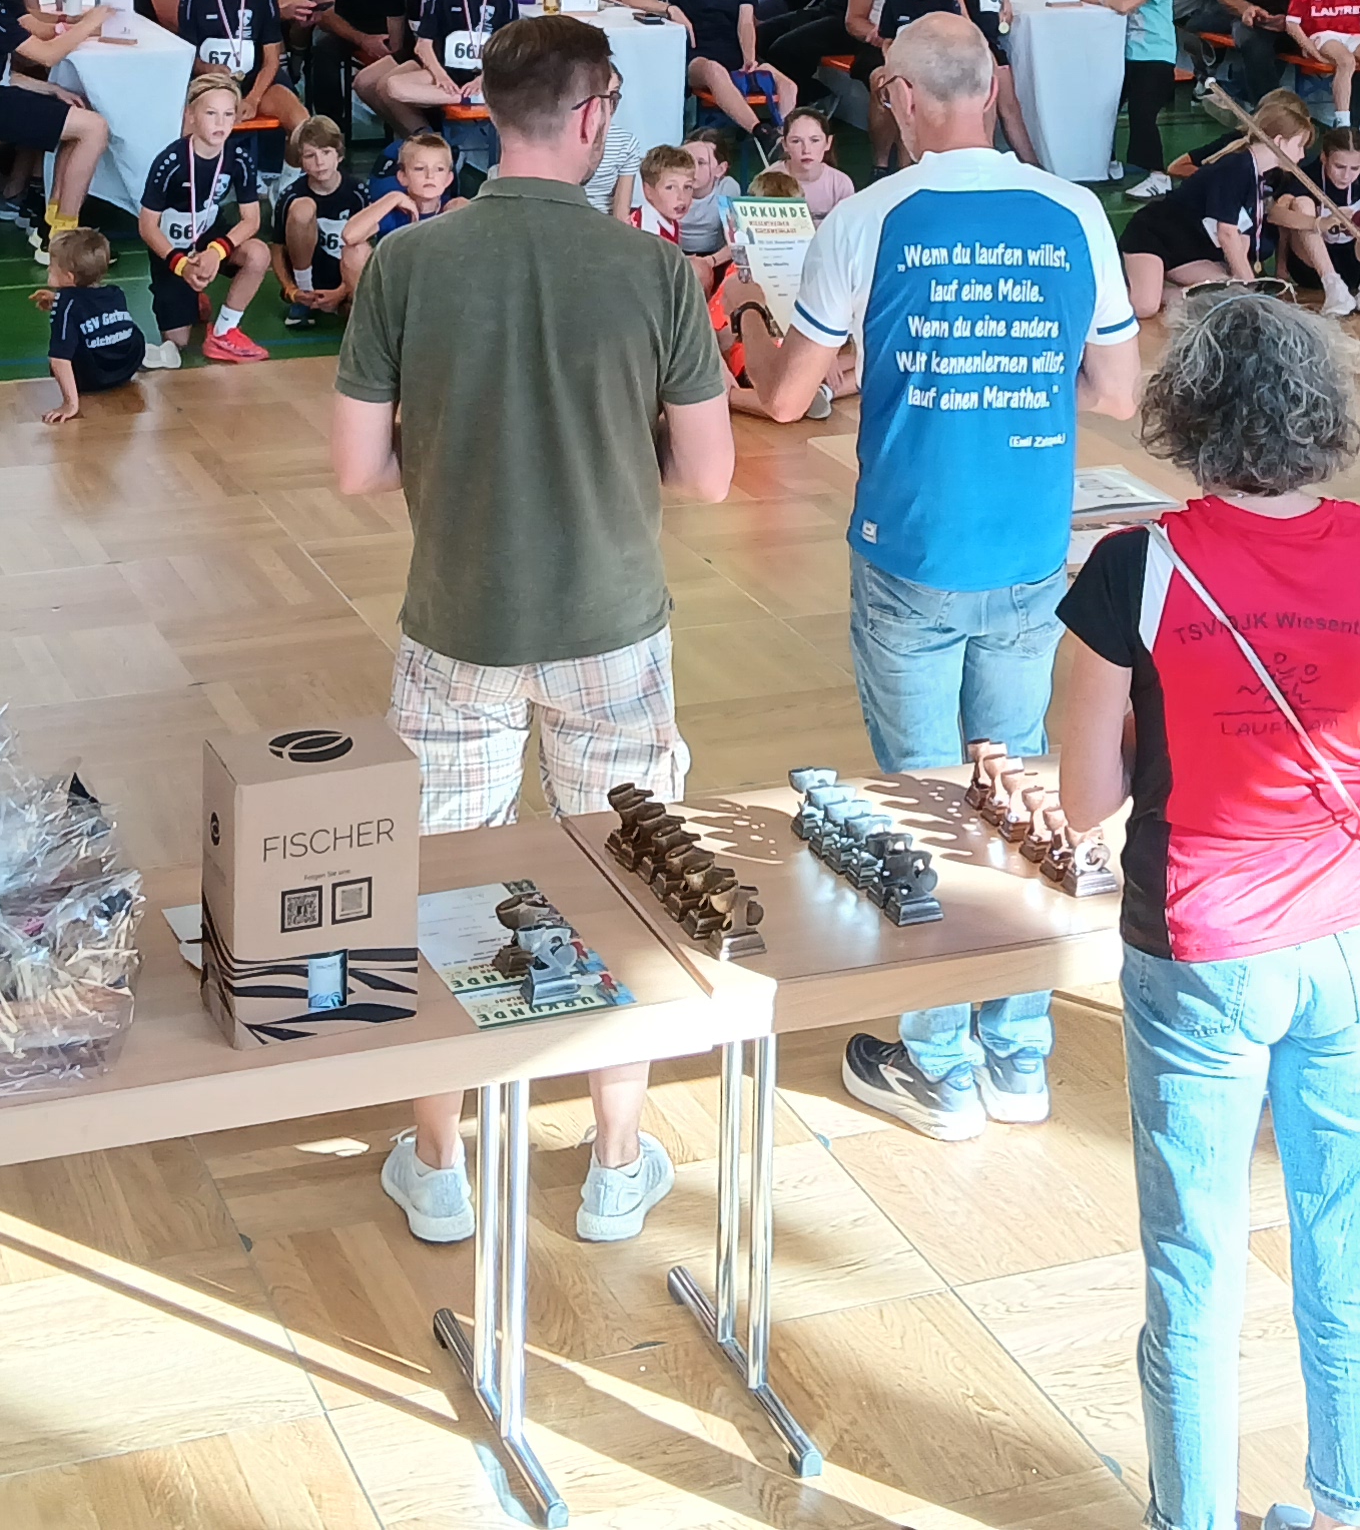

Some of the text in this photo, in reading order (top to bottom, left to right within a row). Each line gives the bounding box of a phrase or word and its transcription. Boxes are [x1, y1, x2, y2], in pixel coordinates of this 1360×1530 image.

[740, 205, 808, 218] URKUNDE
[952, 242, 972, 265] du
[975, 242, 1023, 266] laufen
[1027, 243, 1071, 272] willst,
[930, 278, 1045, 302] lauf eine Meile.
[907, 315, 1059, 338] Wenn du eine andere
[931, 350, 1028, 374] kennenlernen
[907, 385, 938, 408] lauf
[940, 388, 979, 410] einen
[263, 817, 395, 863] FISCHER
